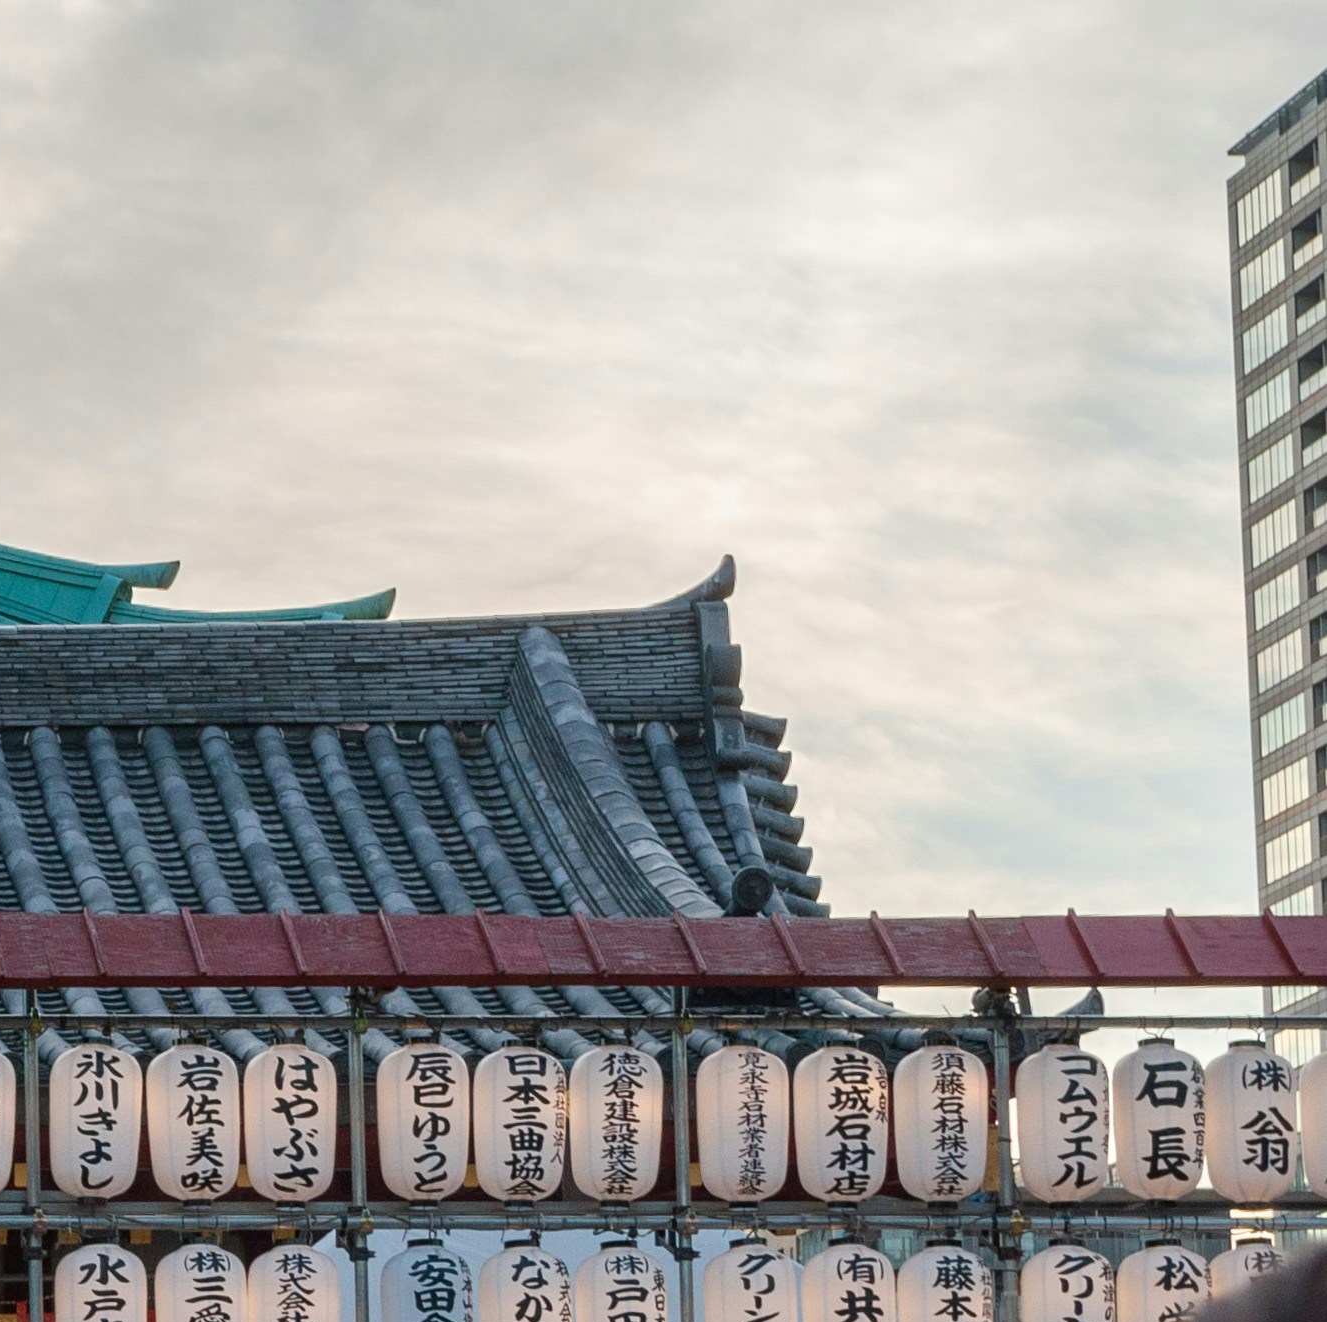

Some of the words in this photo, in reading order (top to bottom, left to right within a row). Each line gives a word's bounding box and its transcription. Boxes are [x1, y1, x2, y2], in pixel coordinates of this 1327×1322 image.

[73, 1050, 124, 1190] 氷川きよし
[177, 1055, 225, 1192] 岩佐美咲
[271, 1055, 319, 1193] はやぶさ
[405, 1052, 456, 1193] 辰巳ゆうと
[502, 1053, 551, 1196] 日本三曲協会
[598, 1053, 648, 1195] 徳倉建設株式会社
[737, 1052, 769, 1195] 寛永寺石材業者連絡会
[825, 1054, 875, 1196] 岩城石材店
[931, 1053, 969, 1196] 須藤石材株式会社
[1135, 1061, 1191, 1182] 石長
[1241, 1060, 1294, 1175] (株)翁
